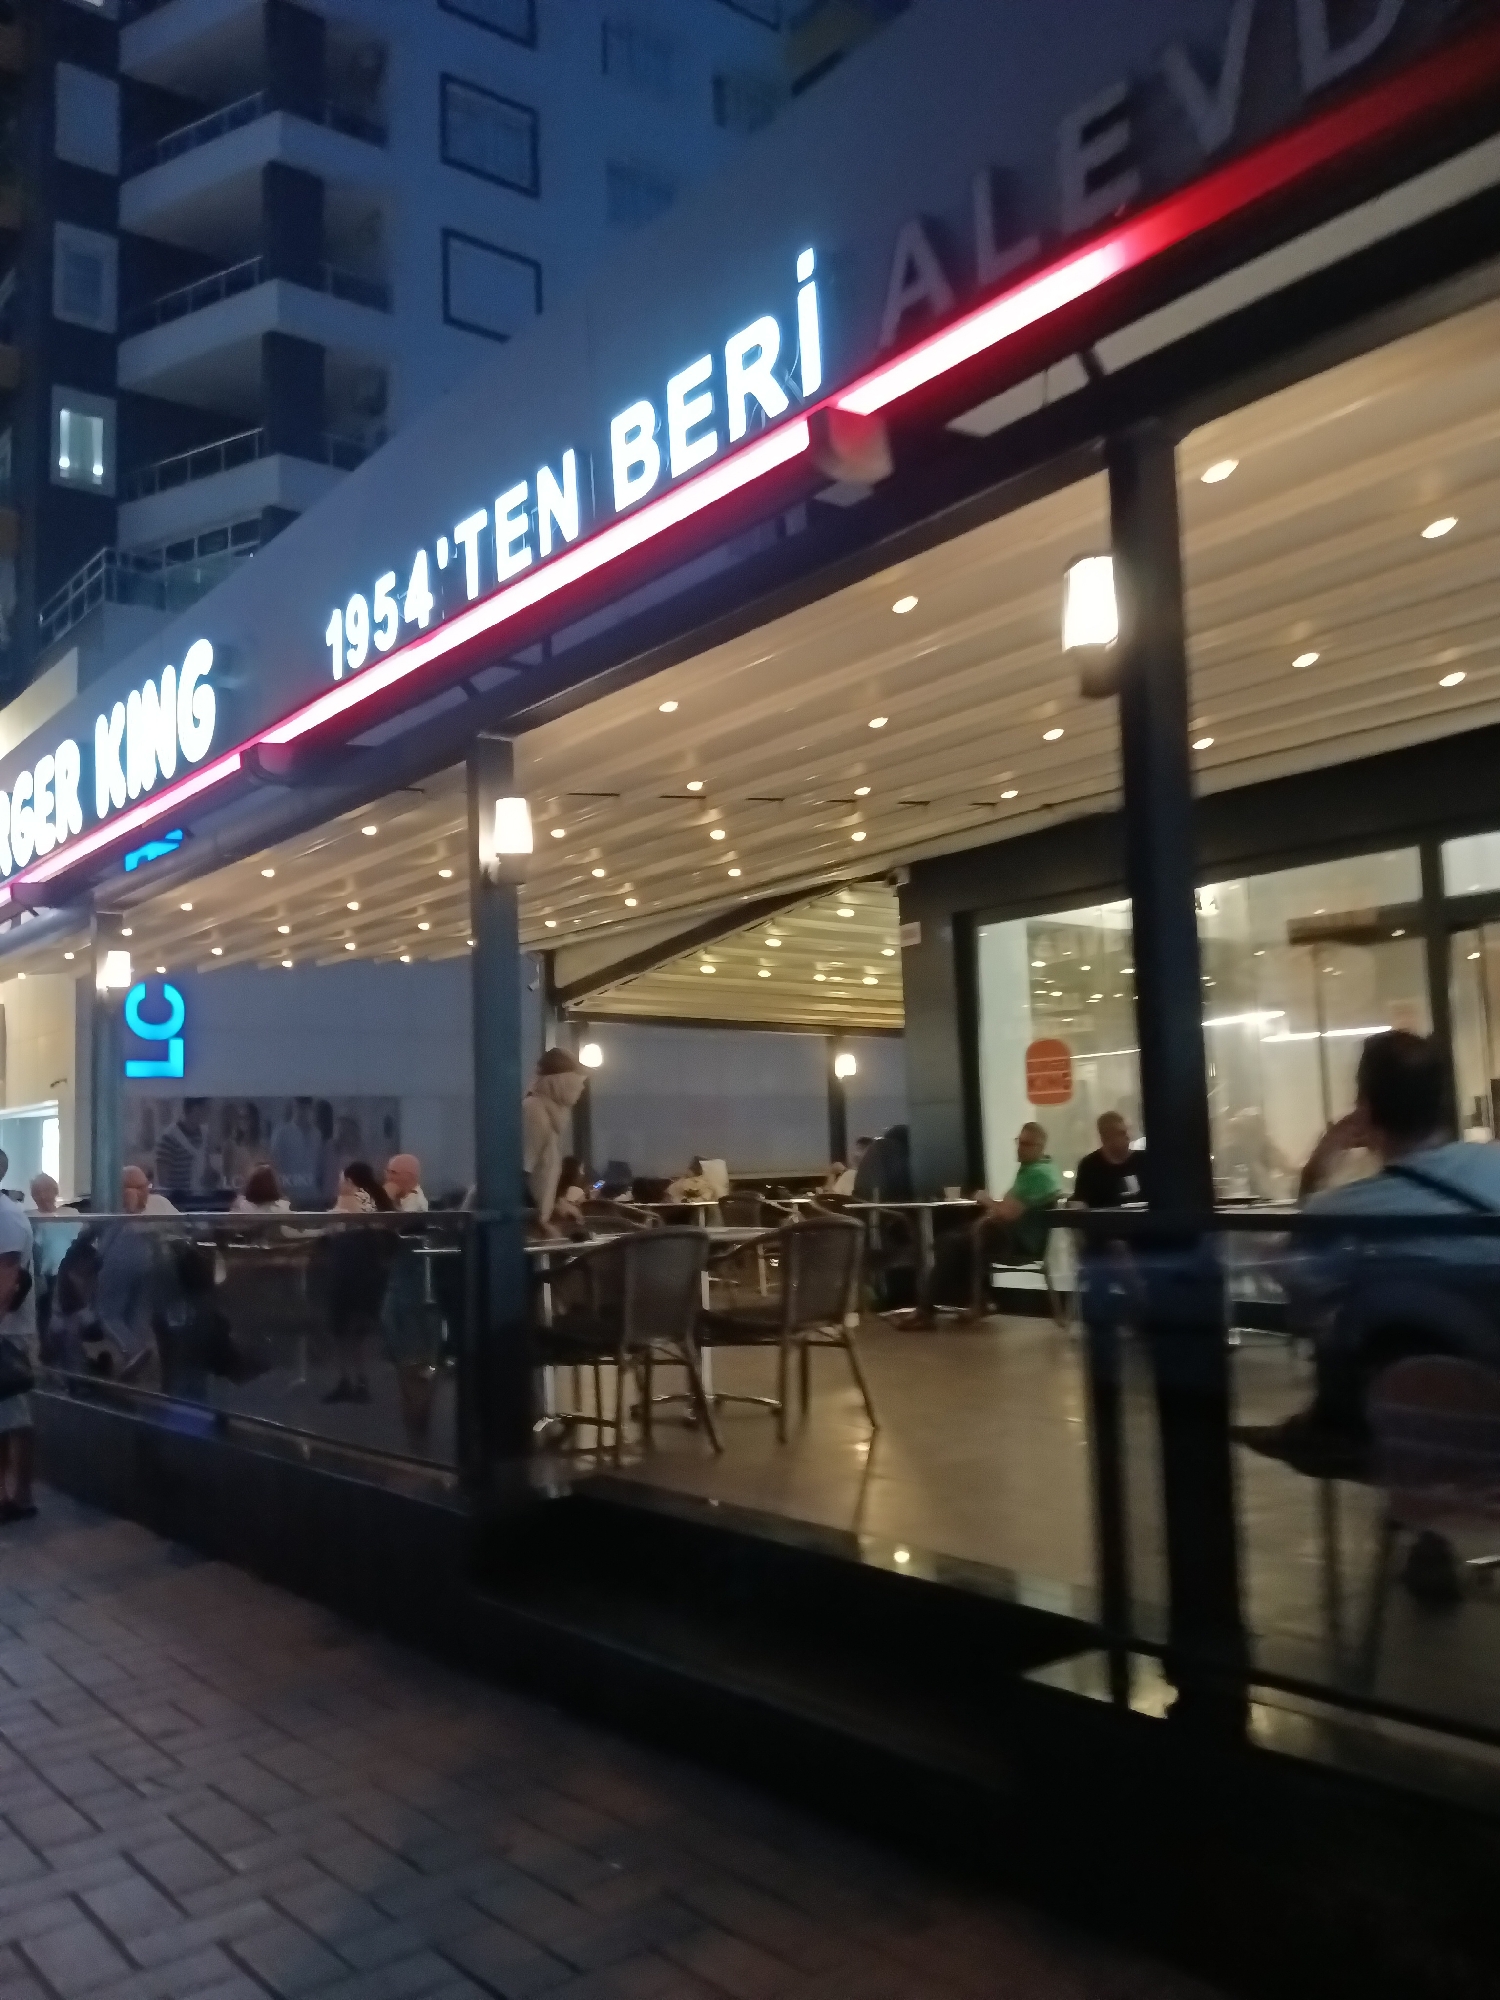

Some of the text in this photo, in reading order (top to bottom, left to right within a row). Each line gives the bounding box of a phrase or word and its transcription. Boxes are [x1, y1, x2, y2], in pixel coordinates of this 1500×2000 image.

[325, 246, 823, 681] 1954'TEN BERİ
[94, 638, 216, 819] KING
[125, 982, 186, 1078] LC
